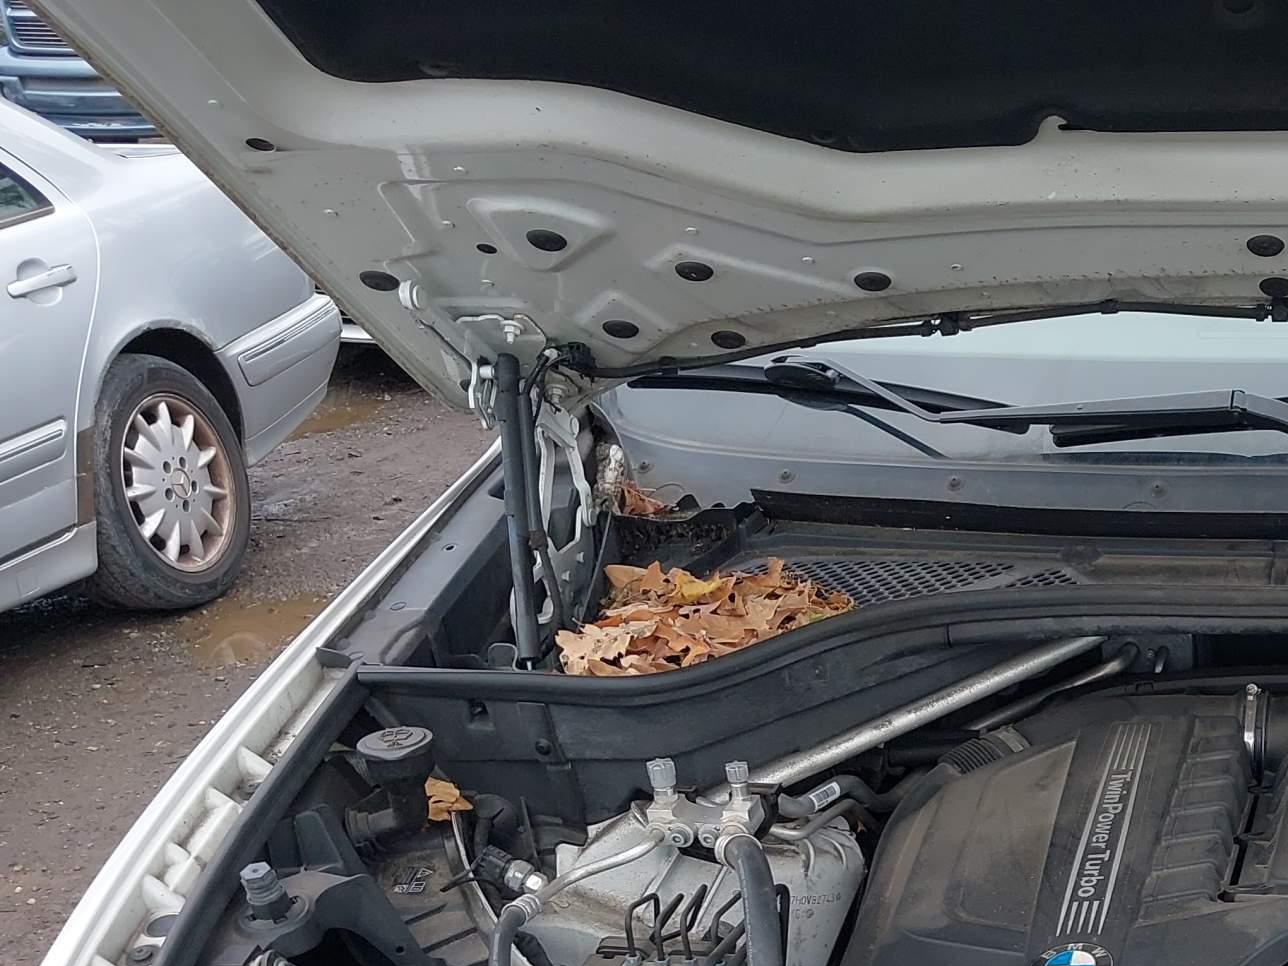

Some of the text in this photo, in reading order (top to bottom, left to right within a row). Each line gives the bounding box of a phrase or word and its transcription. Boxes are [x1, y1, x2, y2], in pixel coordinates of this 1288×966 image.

[1077, 770, 1133, 898] TwinPower Turbo
[1040, 943, 1107, 960] BMW
